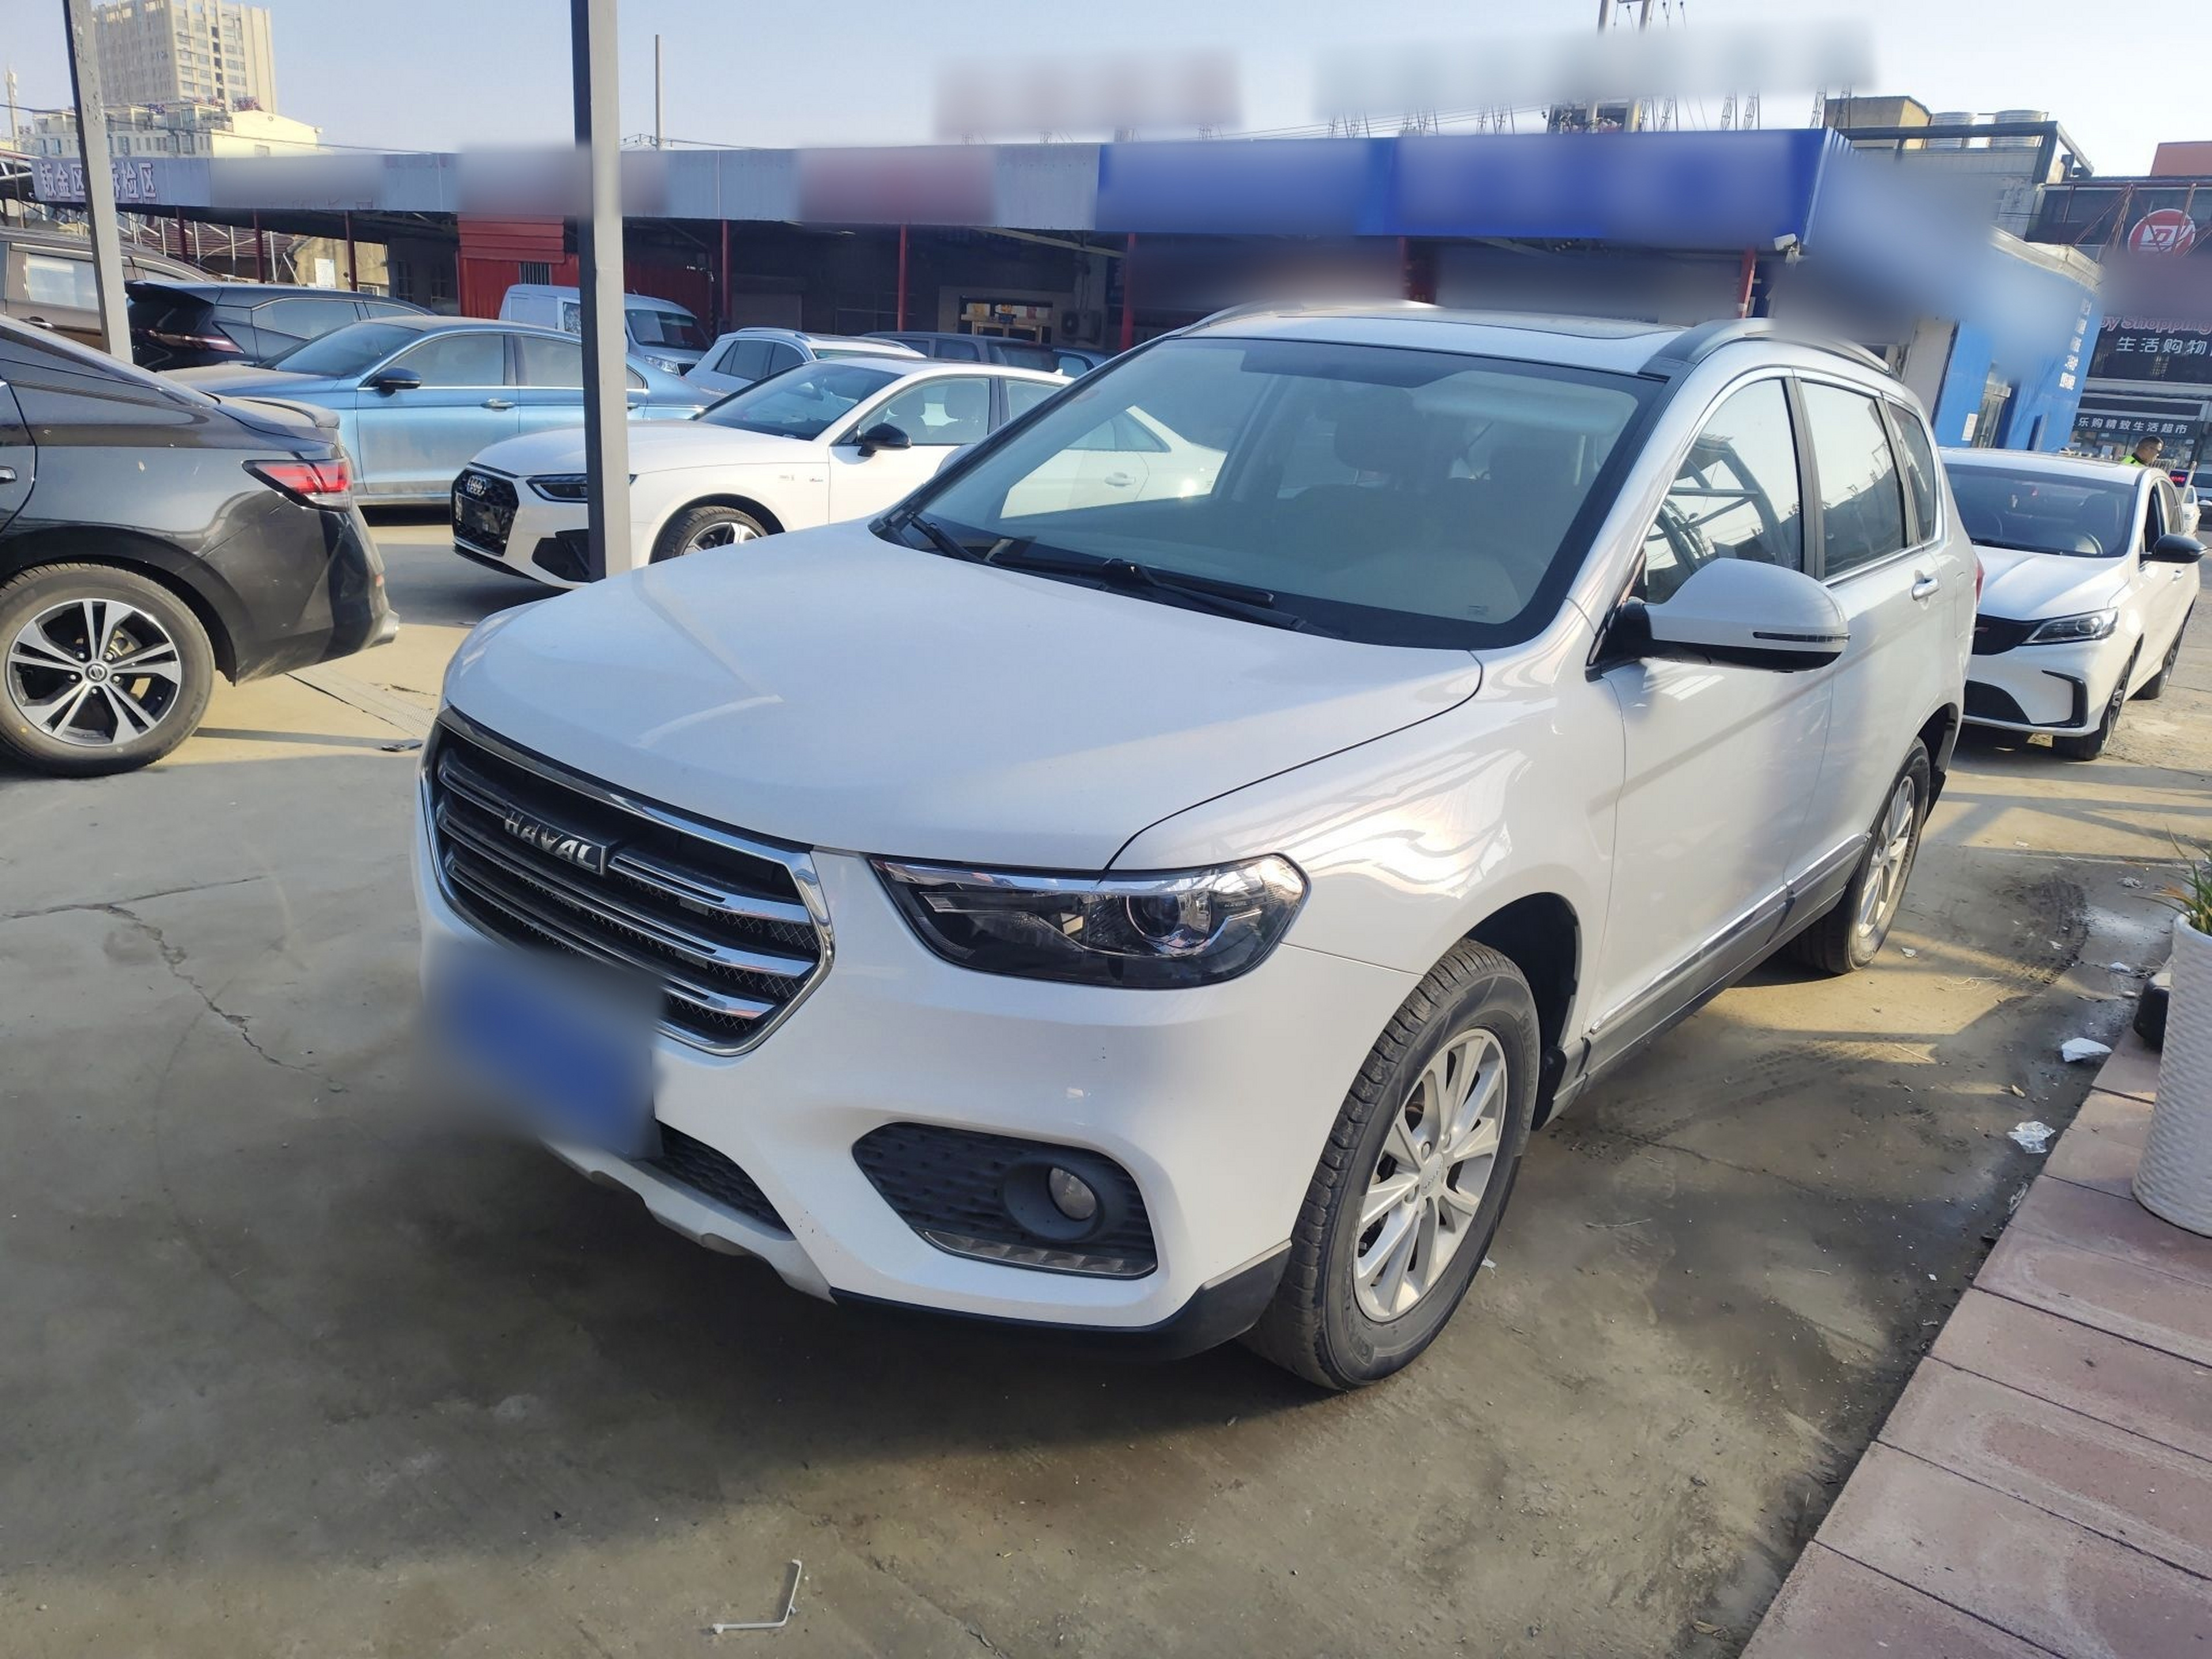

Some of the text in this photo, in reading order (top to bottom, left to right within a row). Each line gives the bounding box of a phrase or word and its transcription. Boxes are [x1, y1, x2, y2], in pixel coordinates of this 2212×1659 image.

[2116, 336, 2212, 357] 生活购物
[504, 812, 597, 870] HAVAL
